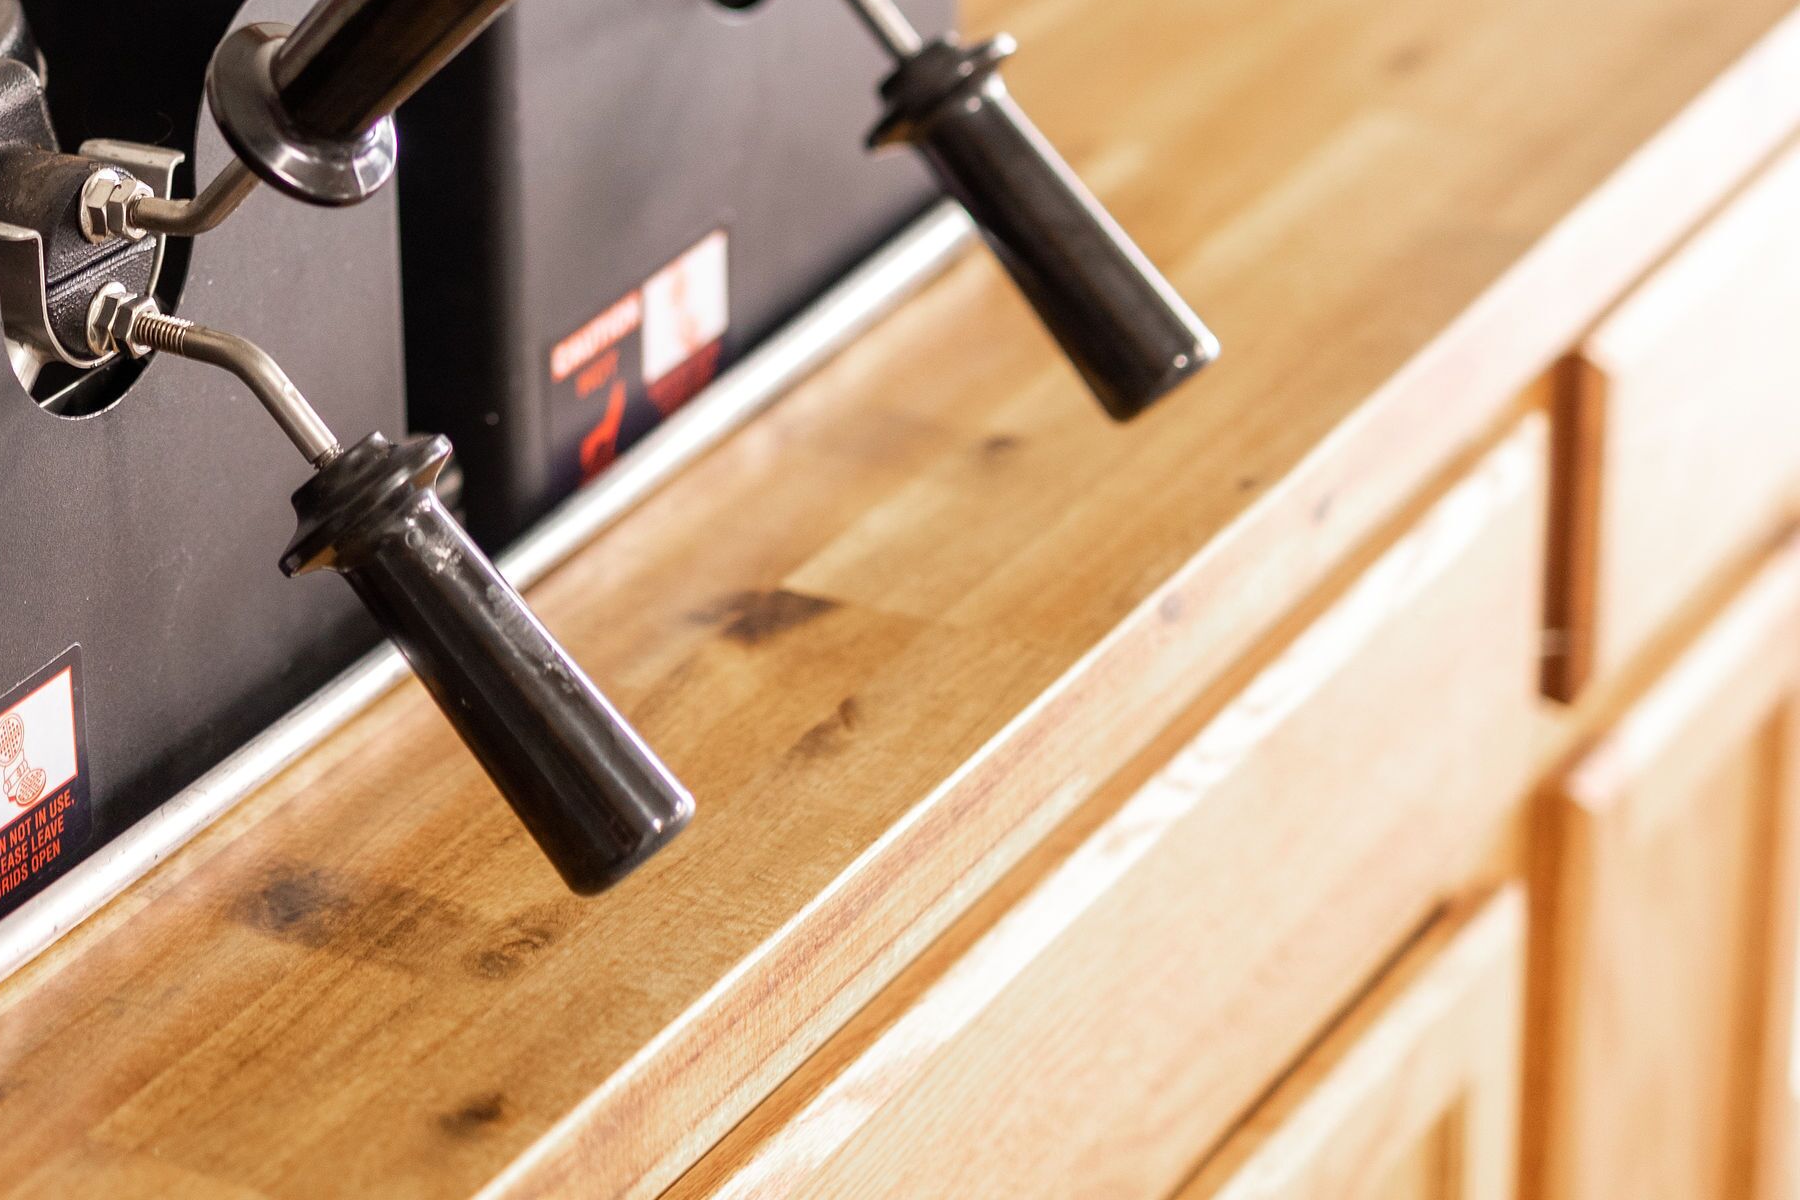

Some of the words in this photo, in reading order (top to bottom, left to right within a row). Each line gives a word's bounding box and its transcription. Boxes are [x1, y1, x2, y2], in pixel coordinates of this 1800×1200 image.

[9, 817, 32, 848] NOT
[34, 806, 47, 830] IN
[31, 814, 64, 854] LEAVE
[31, 838, 60, 873] OPEN
